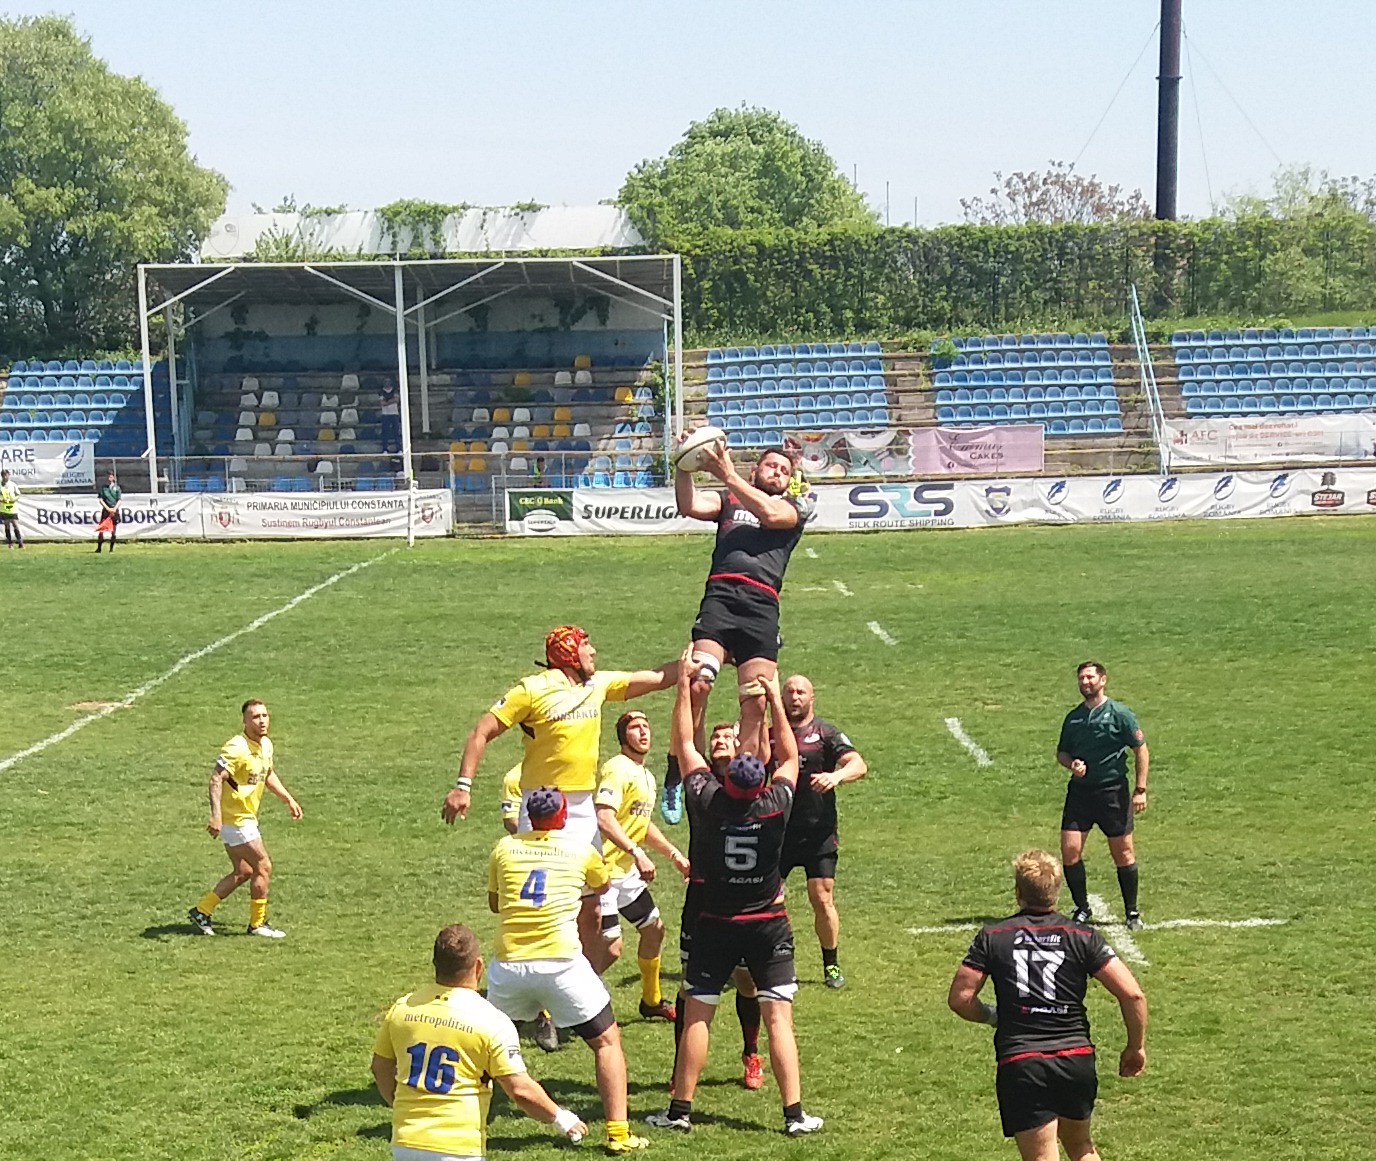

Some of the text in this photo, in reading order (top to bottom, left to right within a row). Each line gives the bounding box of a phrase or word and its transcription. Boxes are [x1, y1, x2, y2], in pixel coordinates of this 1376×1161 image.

[121, 508, 186, 524] BORSEC
[849, 483, 955, 519] SRS
[849, 518, 955, 529] SILK ROUTE SHIPPING
[724, 835, 758, 871] 5
[520, 867, 548, 908] 4
[1012, 949, 1066, 1001] 17
[404, 1012, 474, 1035] metropolitan
[406, 1042, 460, 1095] 16
